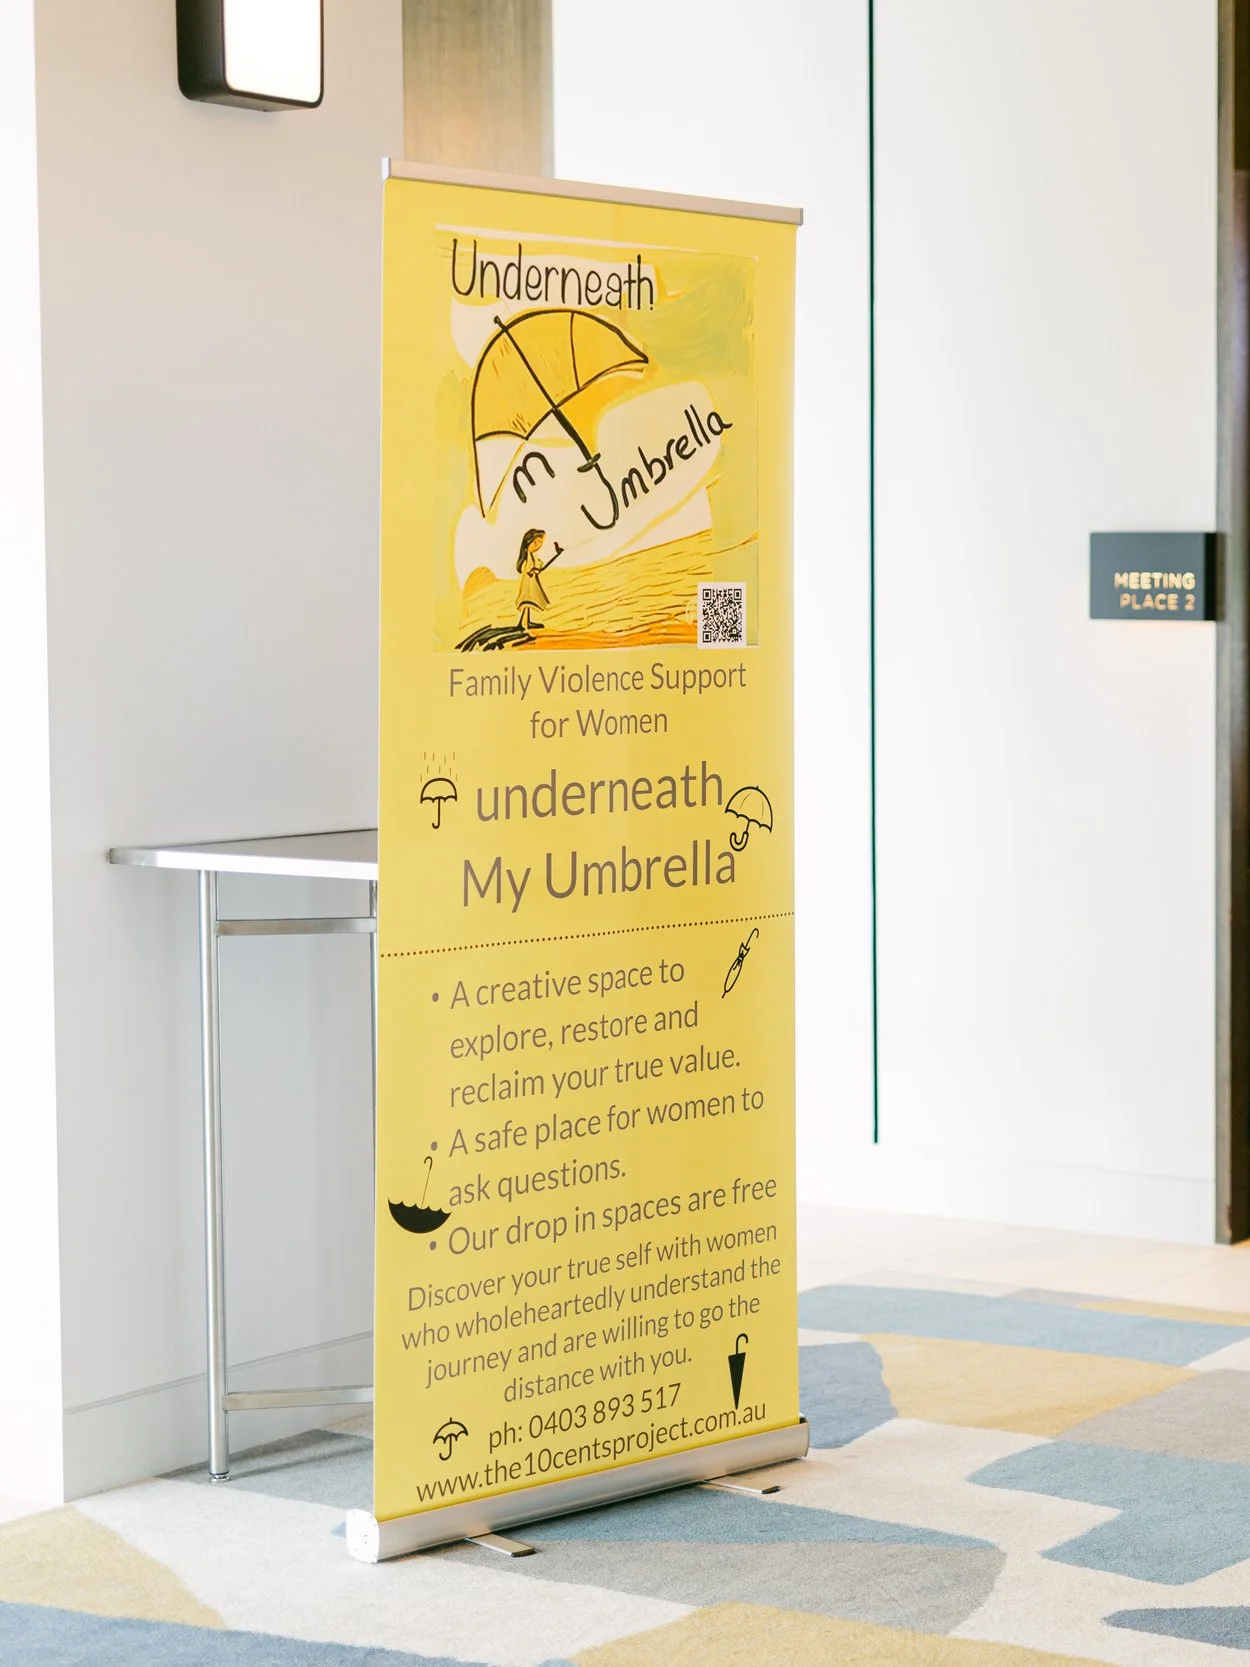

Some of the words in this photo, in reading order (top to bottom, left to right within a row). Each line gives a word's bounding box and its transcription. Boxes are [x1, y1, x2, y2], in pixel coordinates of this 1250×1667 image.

[452, 238, 654, 310] Underneath
[1114, 572, 1195, 590] MEETING
[1120, 593, 1179, 611] PLACE
[1184, 593, 1195, 611] 2
[450, 666, 532, 700] Family
[538, 664, 644, 693] Violence
[651, 662, 746, 695] Support
[530, 711, 569, 739] for
[576, 709, 667, 736] Women
[477, 760, 722, 822] underneath
[464, 857, 531, 913] My
[546, 839, 735, 899] Umbrella
[450, 981, 469, 1009] A
[476, 970, 581, 1005] creative
[588, 966, 652, 998] space
[659, 959, 684, 984] to
[451, 1024, 553, 1061] explore,
[562, 1014, 647, 1044] restore
[654, 1000, 697, 1031] and
[451, 1070, 544, 1107] reclaim
[552, 1066, 609, 1099] your
[614, 1058, 663, 1083] true
[670, 1045, 740, 1074] value.
[449, 1129, 468, 1158] A
[475, 1120, 527, 1152] safe
[536, 1113, 600, 1150] place
[607, 1105, 641, 1132] for
[647, 1095, 734, 1125] women
[741, 1088, 764, 1111] to
[449, 1173, 491, 1206] ask
[498, 1159, 625, 1202] questions.
[449, 1227, 499, 1254] Our
[506, 1216, 567, 1244] drop
[575, 1206, 595, 1233] in
[602, 1196, 681, 1232] spaces
[688, 1188, 726, 1212] are
[732, 1178, 776, 1204] free
[409, 1276, 506, 1311] Discover
[511, 1265, 562, 1296] your
[567, 1257, 610, 1280] true
[616, 1241, 652, 1270] self
[656, 1233, 701, 1262] with
[706, 1225, 776, 1252] women
[401, 1322, 449, 1350] who
[456, 1286, 625, 1339] wholeheartedly
[631, 1259, 745, 1303] understand
[750, 1256, 780, 1279] the
[426, 1348, 512, 1389] journey
[518, 1333, 556, 1363] and
[563, 1332, 597, 1353] are
[602, 1315, 669, 1344] willing
[673, 1309, 694, 1329] to
[700, 1305, 723, 1329] go
[728, 1295, 760, 1318] the
[504, 1368, 594, 1402] distance
[600, 1352, 644, 1381] with
[650, 1347, 691, 1375] you.
[489, 1421, 522, 1454] ph:
[529, 1405, 587, 1439] 0403
[593, 1394, 634, 1424] 893
[641, 1383, 681, 1413] 517
[416, 1401, 766, 1502] www.the10centsproject.com.au
